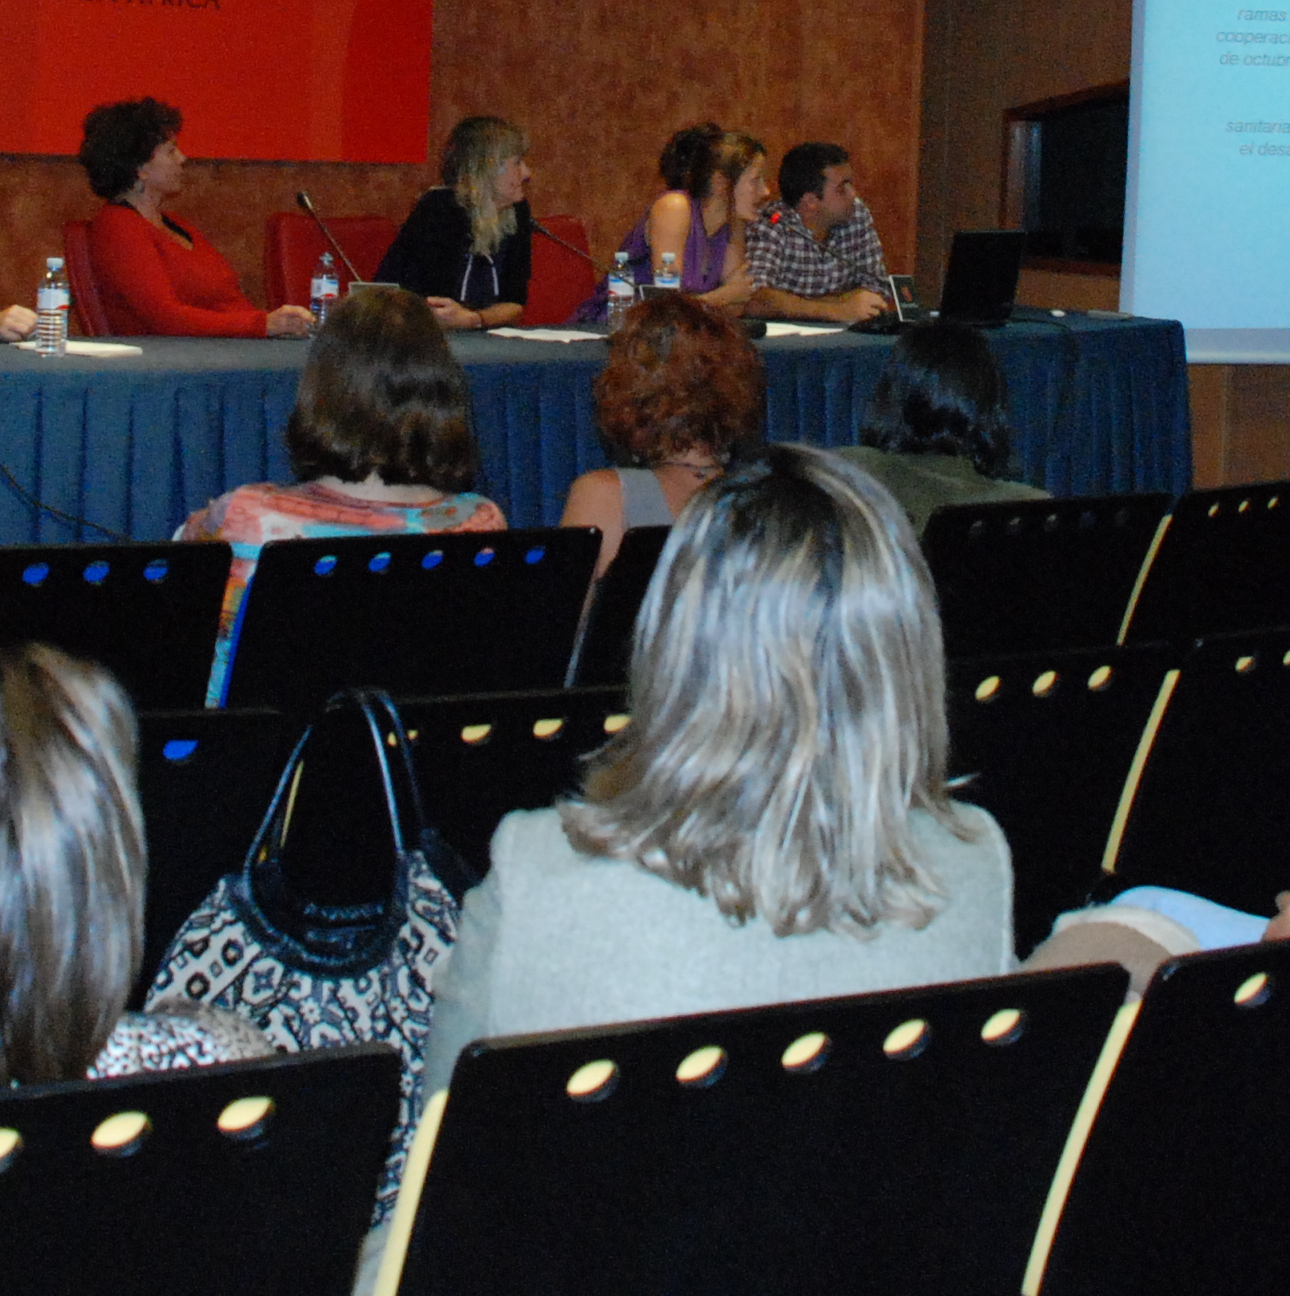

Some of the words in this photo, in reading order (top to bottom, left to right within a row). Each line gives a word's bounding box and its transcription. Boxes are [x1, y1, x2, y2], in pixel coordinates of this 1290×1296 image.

[1237, 9, 1286, 22] ramas
[1219, 51, 1239, 65] de
[1225, 120, 1290, 134] sanitaria
[1239, 142, 1254, 156] el
